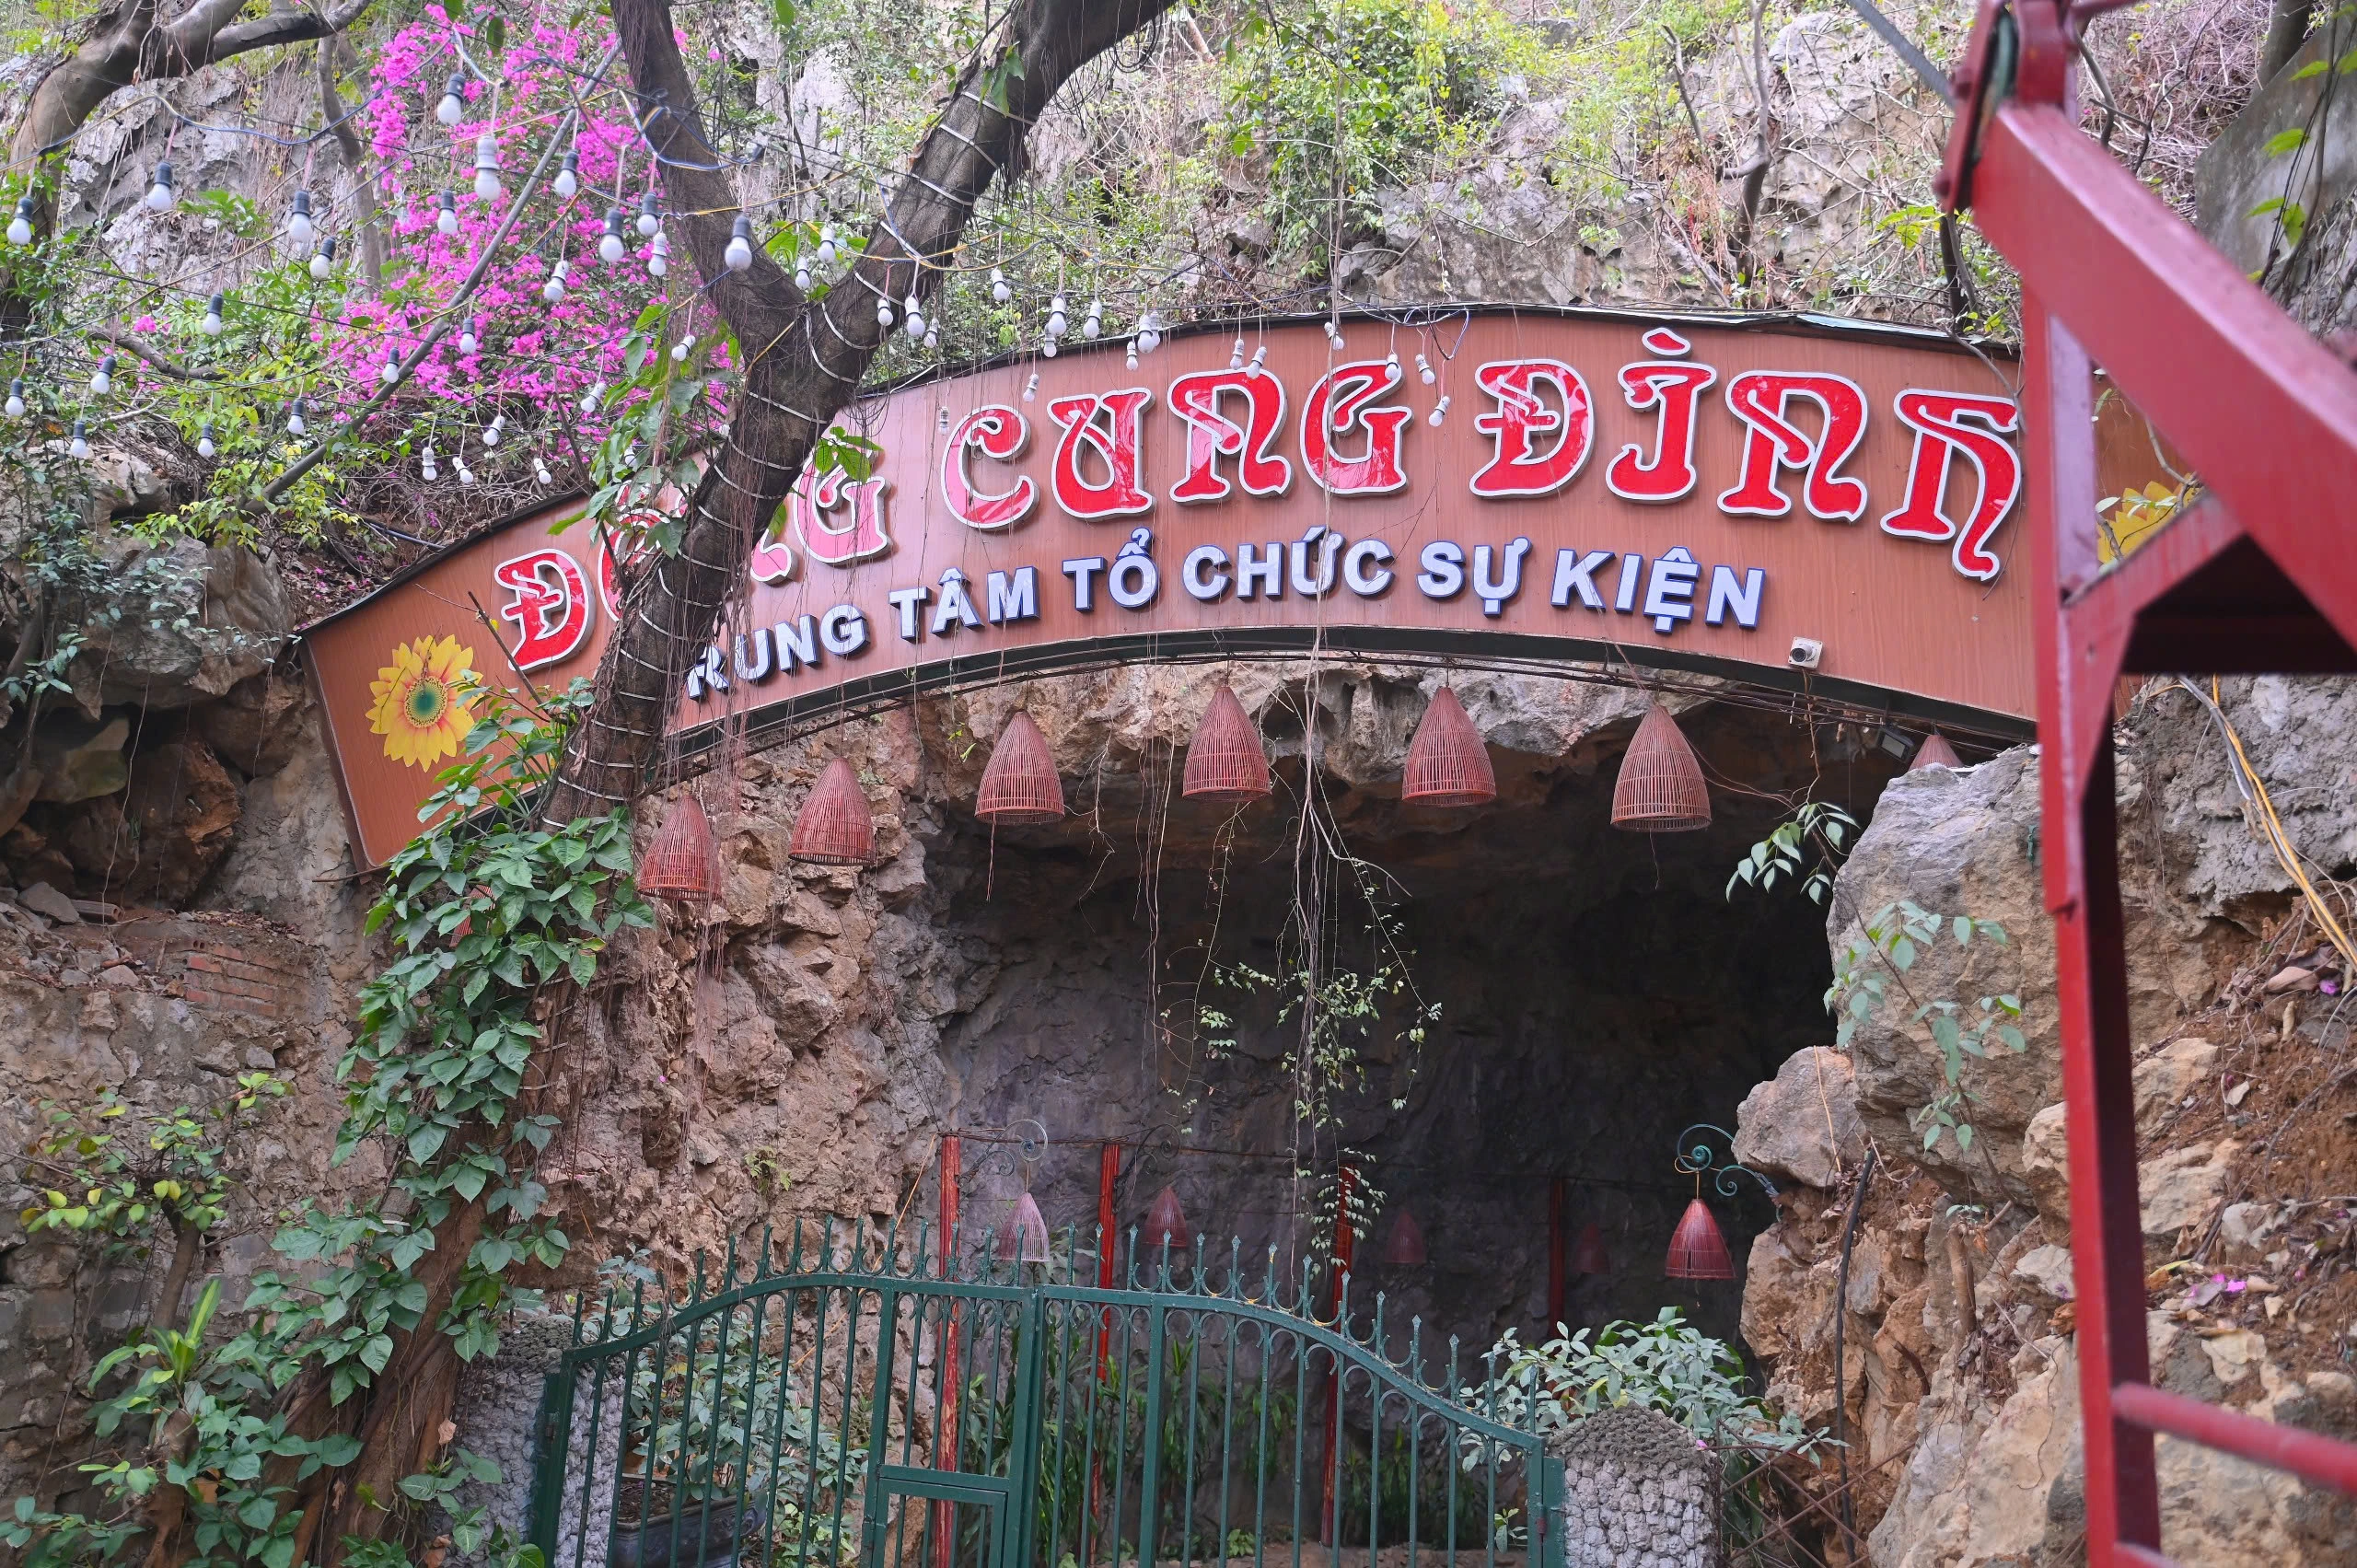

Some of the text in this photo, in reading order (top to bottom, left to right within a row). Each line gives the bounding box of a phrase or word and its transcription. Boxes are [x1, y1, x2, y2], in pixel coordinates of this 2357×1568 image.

[940, 359, 1414, 531] CUNG
[686, 525, 1767, 701] RUNG TÂM TỔ CHỨC SỰ KIỆN
